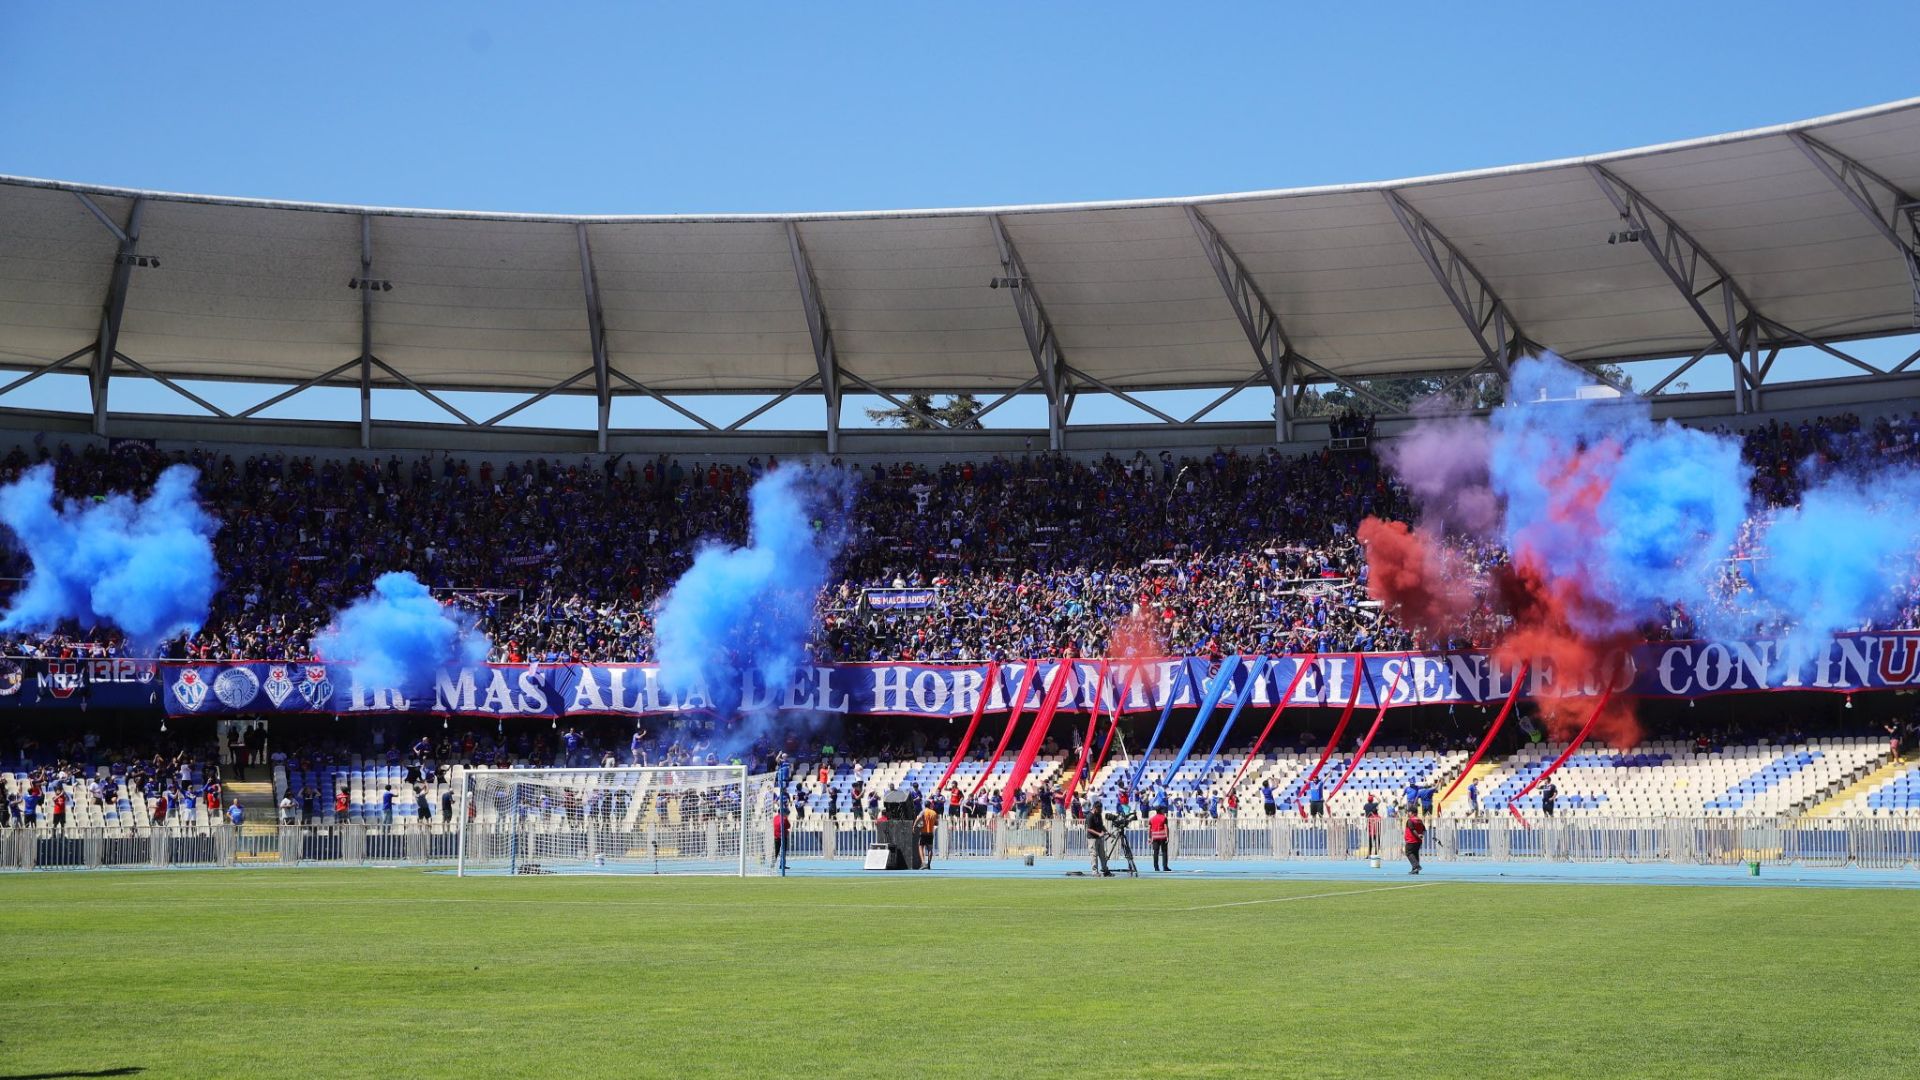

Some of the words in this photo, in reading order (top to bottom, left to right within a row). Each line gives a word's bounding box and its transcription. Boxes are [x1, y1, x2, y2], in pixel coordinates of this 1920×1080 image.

[882, 595, 925, 605] MALCRIADOS
[88, 660, 136, 683] 1312
[432, 667, 548, 713] MAS
[568, 667, 716, 712] ALLA
[738, 667, 849, 713] DEL
[870, 661, 1191, 713] HORIZONTE
[1243, 659, 1280, 703] Y
[1291, 658, 1362, 704] EL
[1656, 635, 1920, 695] CONTINU
